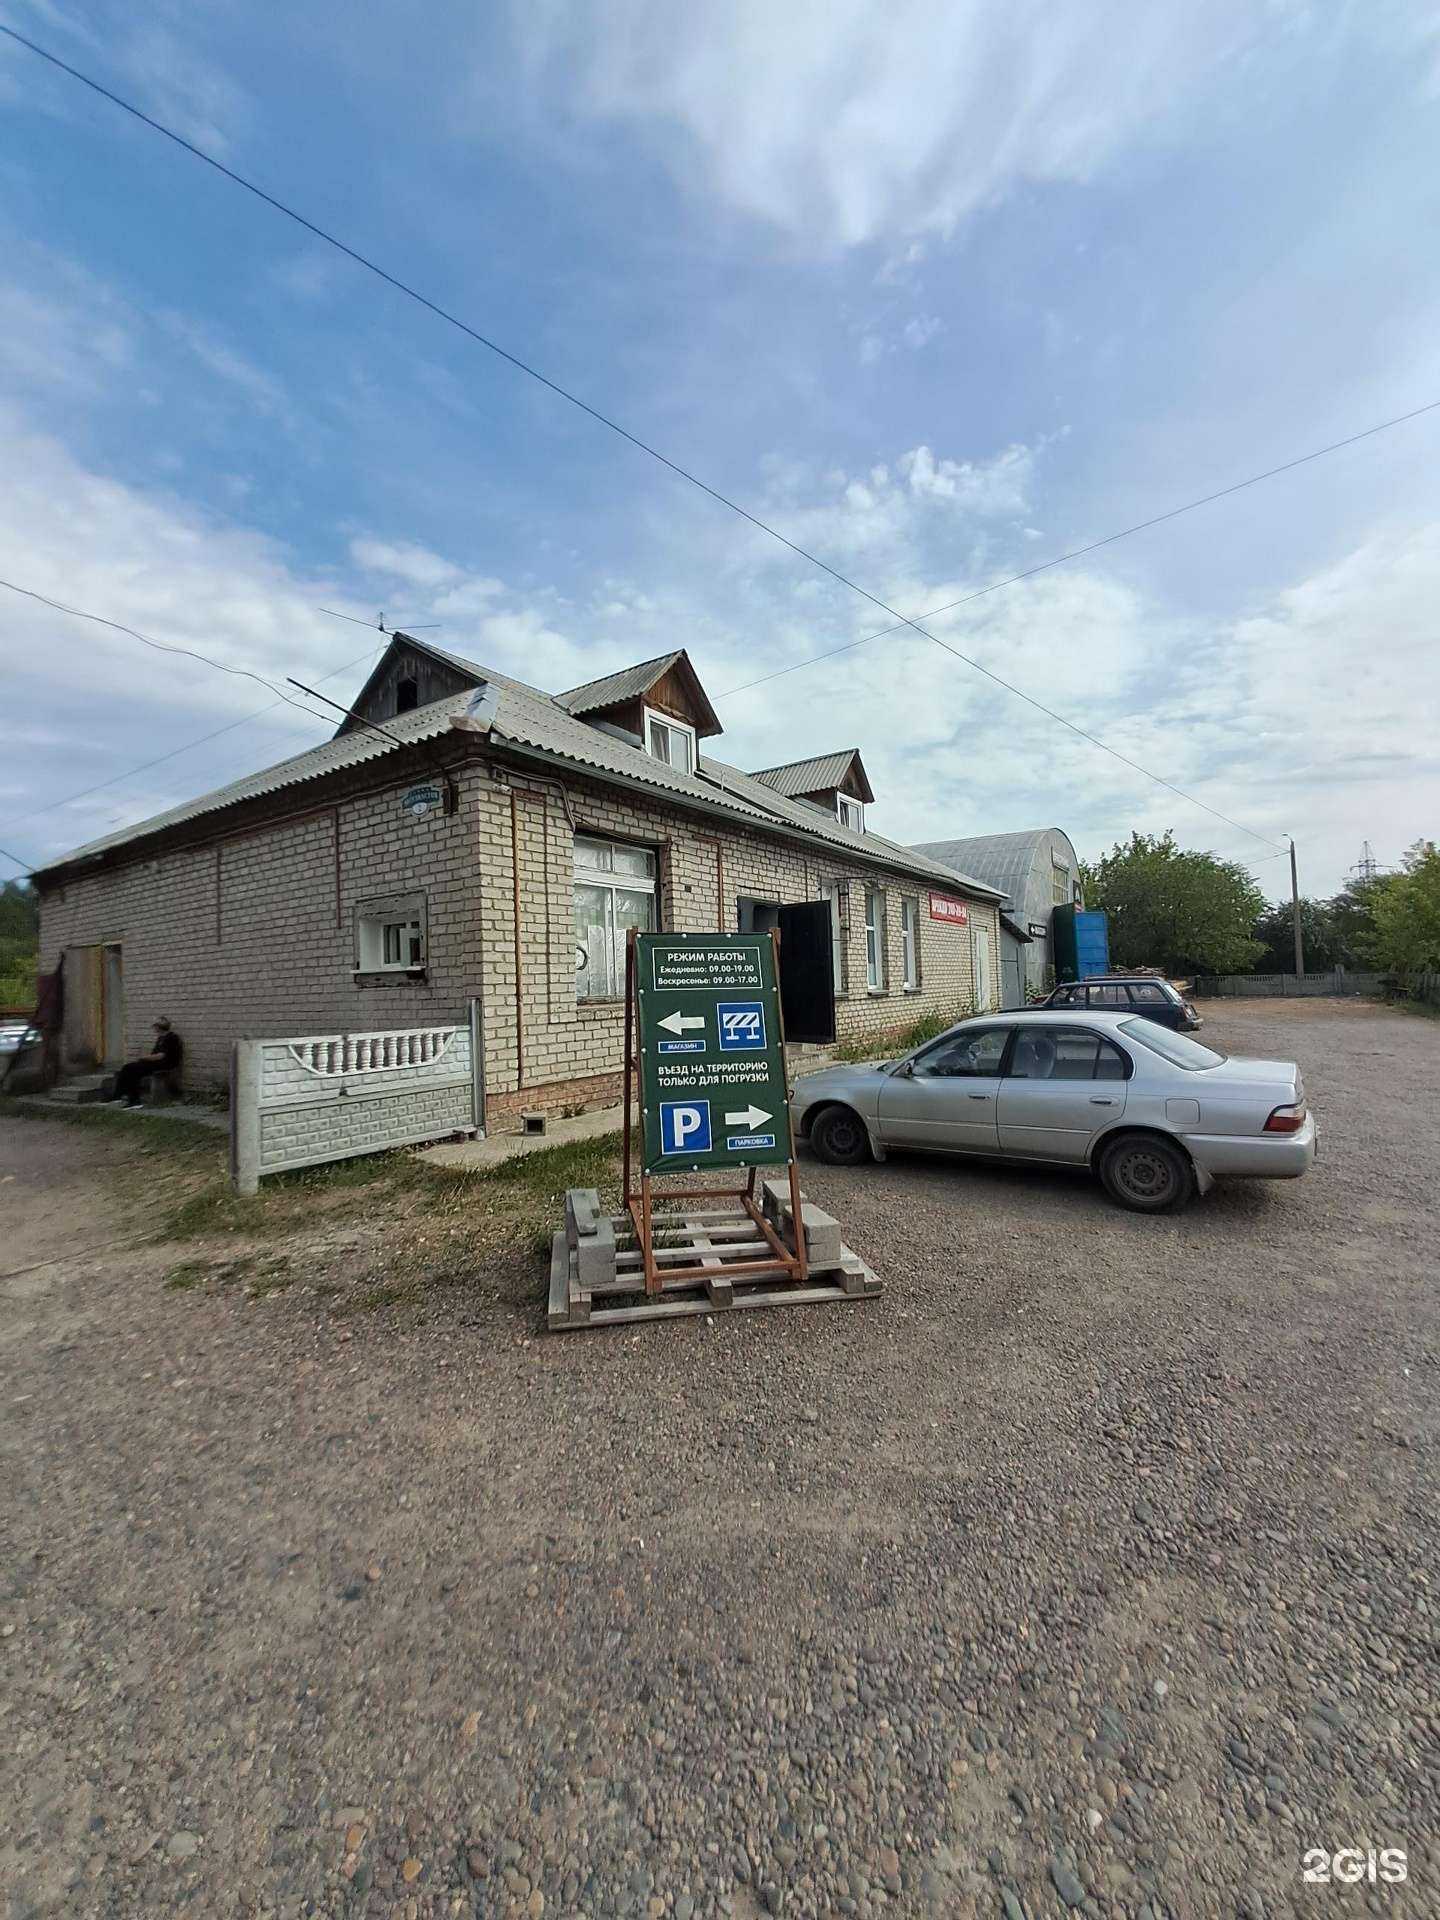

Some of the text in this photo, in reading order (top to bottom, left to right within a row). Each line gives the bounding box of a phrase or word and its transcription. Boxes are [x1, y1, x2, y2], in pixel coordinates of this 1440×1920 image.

[667, 952, 746, 962] РЕЖИМ РАБОТЫ
[660, 964, 755, 974] Ежедневно: 09.00-19.00
[658, 975, 758, 986] Воскресенье: 09.00-17.00
[668, 1042, 698, 1050] МАГАЗИН
[658, 1061, 768, 1076] ВЪЕЗД НА ТЕРРИТОРИЮ
[659, 1072, 770, 1087] ТОЛЬКО ДЛЯ ПОГРУЗКИ
[734, 1138, 769, 1147] ПАРКОВКА
